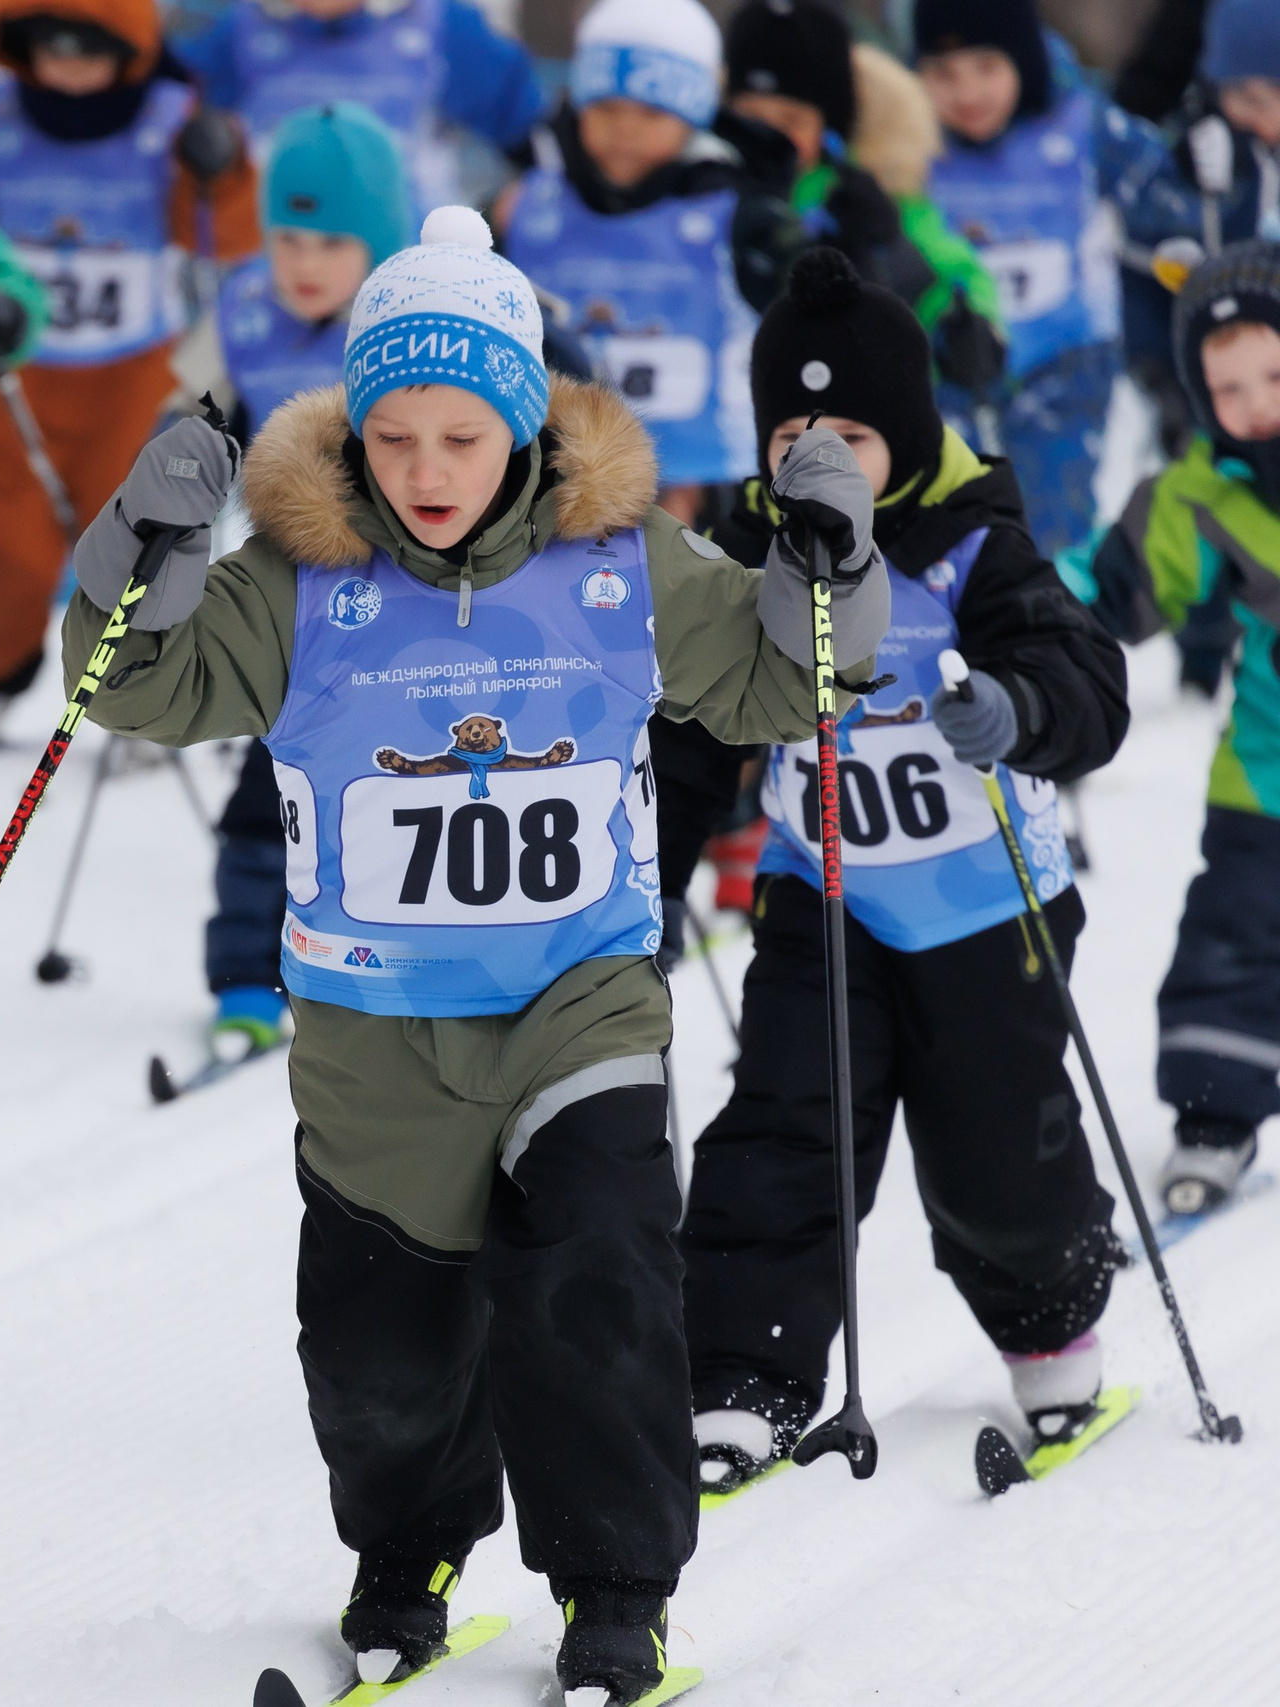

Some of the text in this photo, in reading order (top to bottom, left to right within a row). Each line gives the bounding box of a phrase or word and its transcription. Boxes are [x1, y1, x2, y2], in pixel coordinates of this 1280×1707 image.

[48, 273, 121, 330] 34
[56, 576, 148, 736] SABLE
[351, 657, 497, 686] МЕЖДУНАРОДНЫЙ
[405, 676, 561, 700] ЛЫЖНЫЙ МАРАФОН
[393, 798, 581, 906] 708
